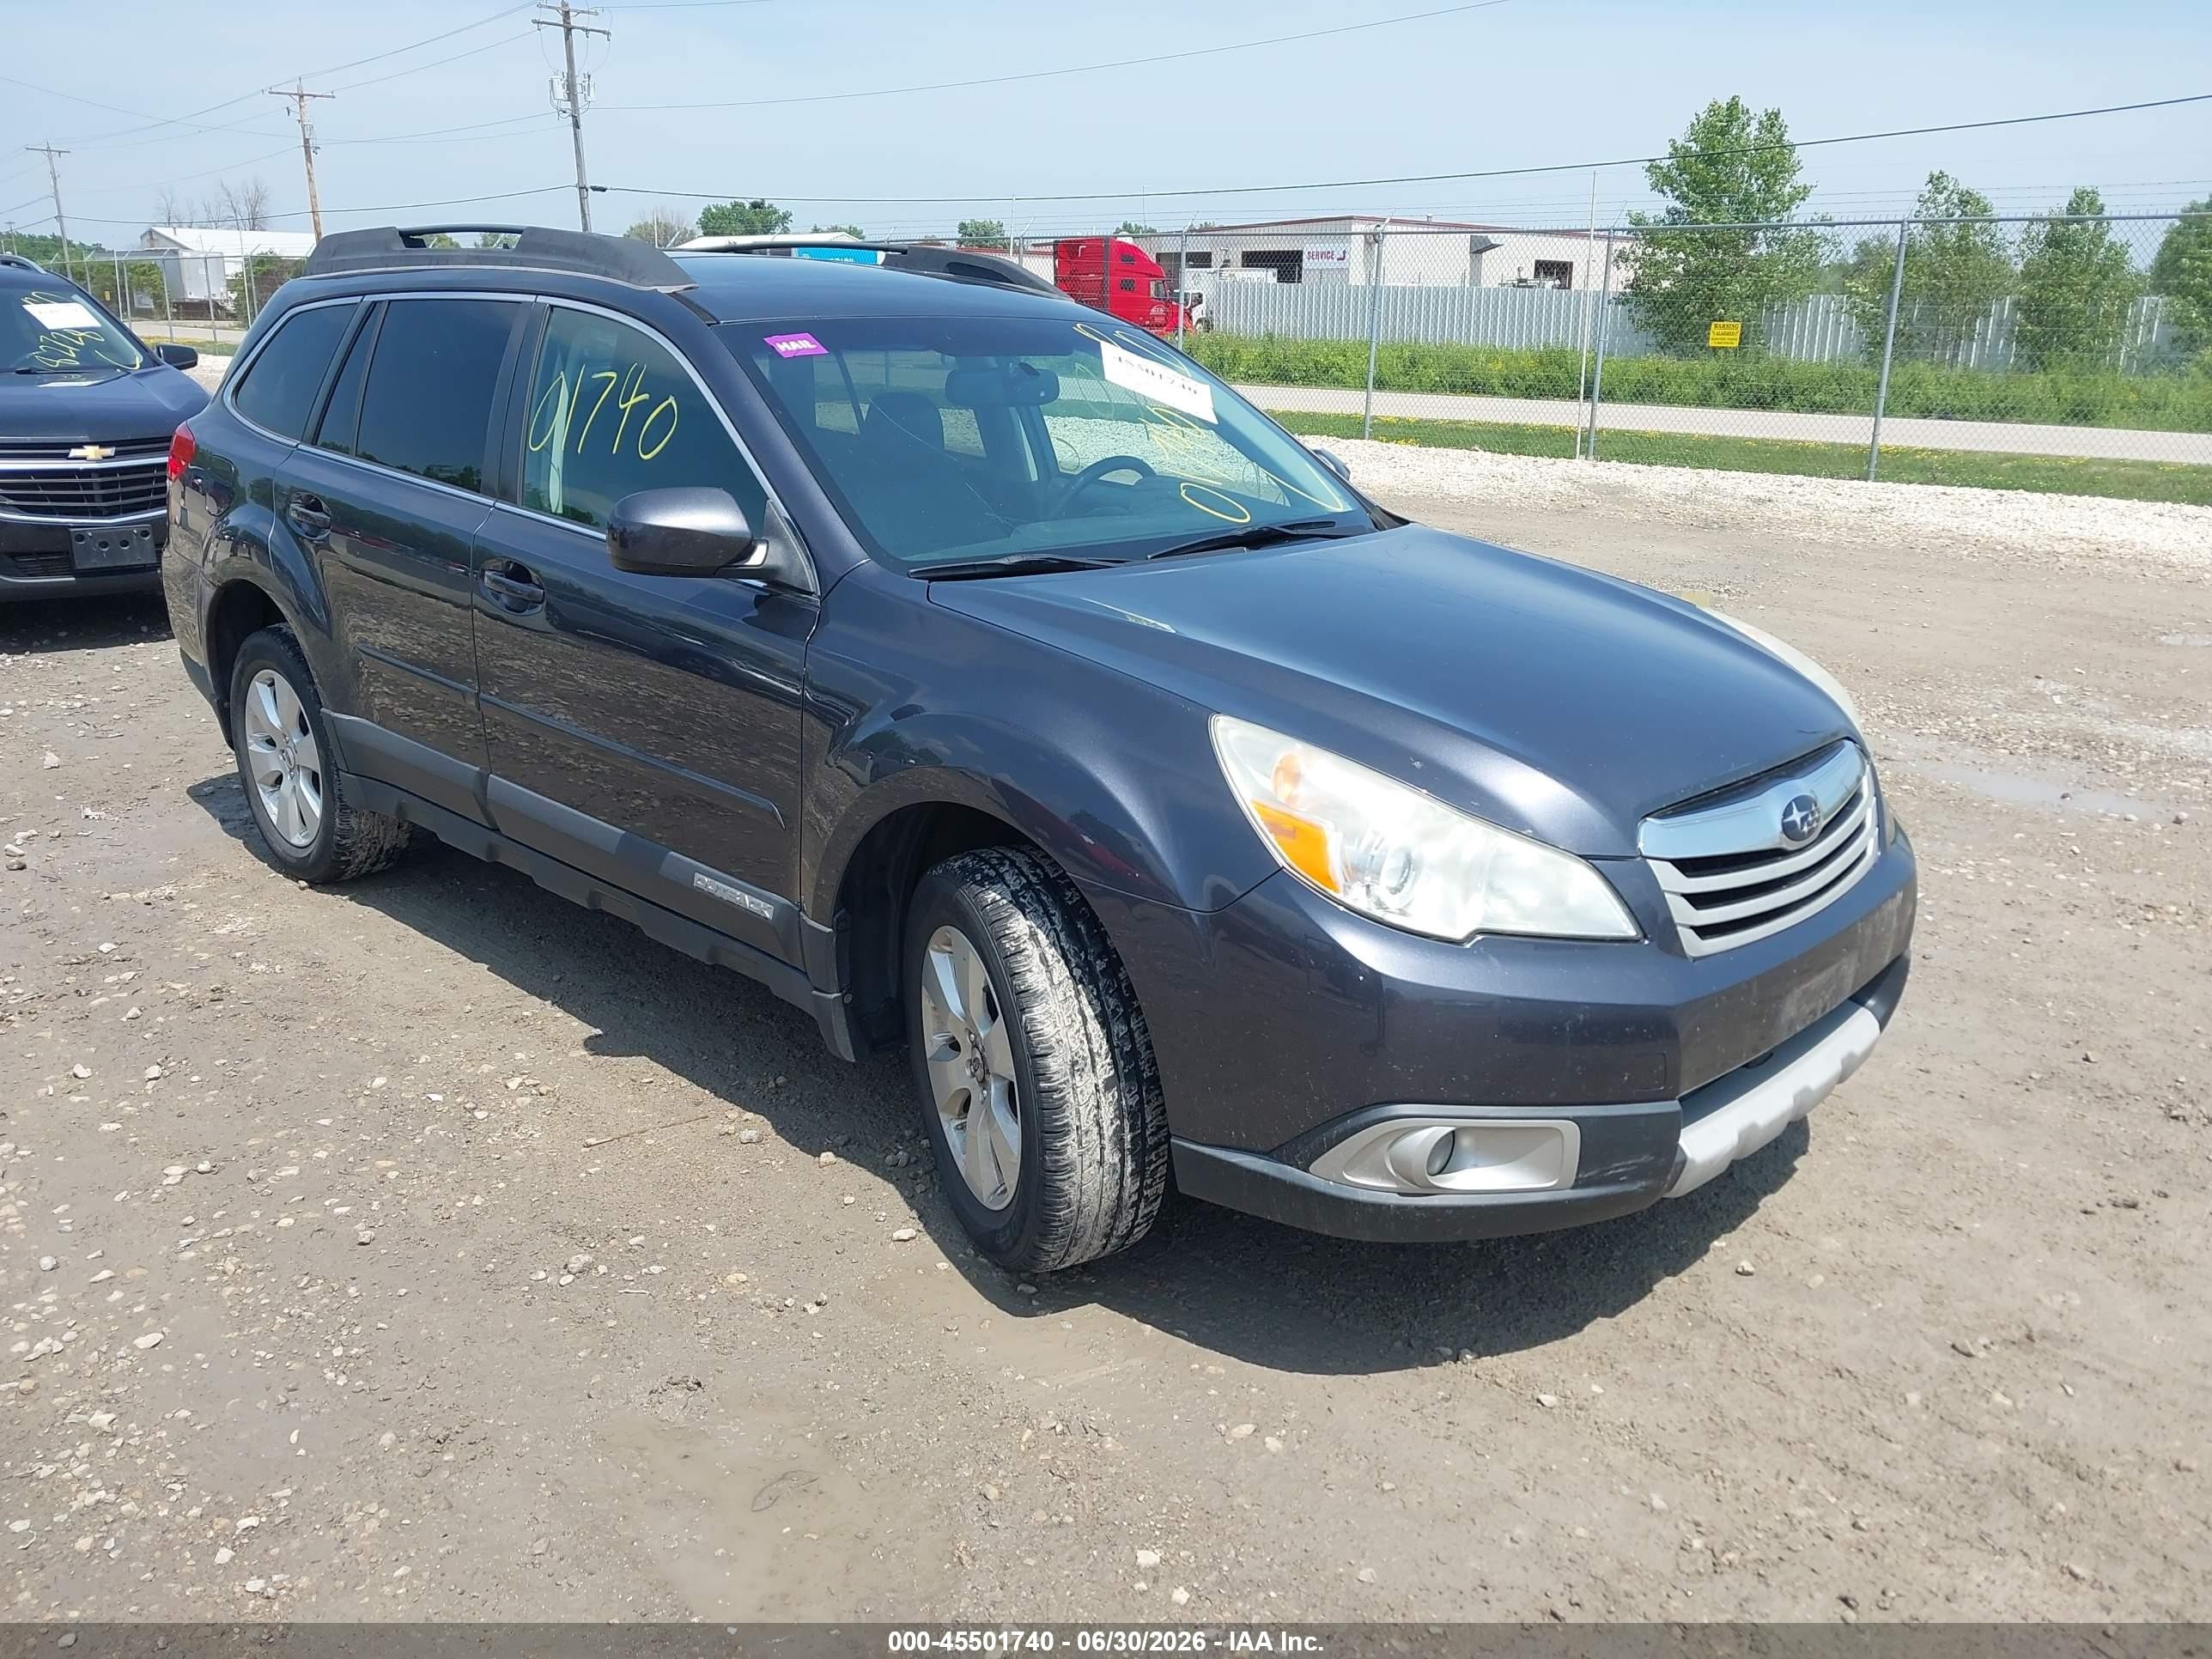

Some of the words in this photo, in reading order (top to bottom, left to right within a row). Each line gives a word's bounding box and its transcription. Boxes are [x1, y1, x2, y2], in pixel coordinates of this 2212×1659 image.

[1307, 250, 1334, 261] SERVICE
[775, 339, 817, 351] HAIL
[529, 362, 678, 459] 01740
